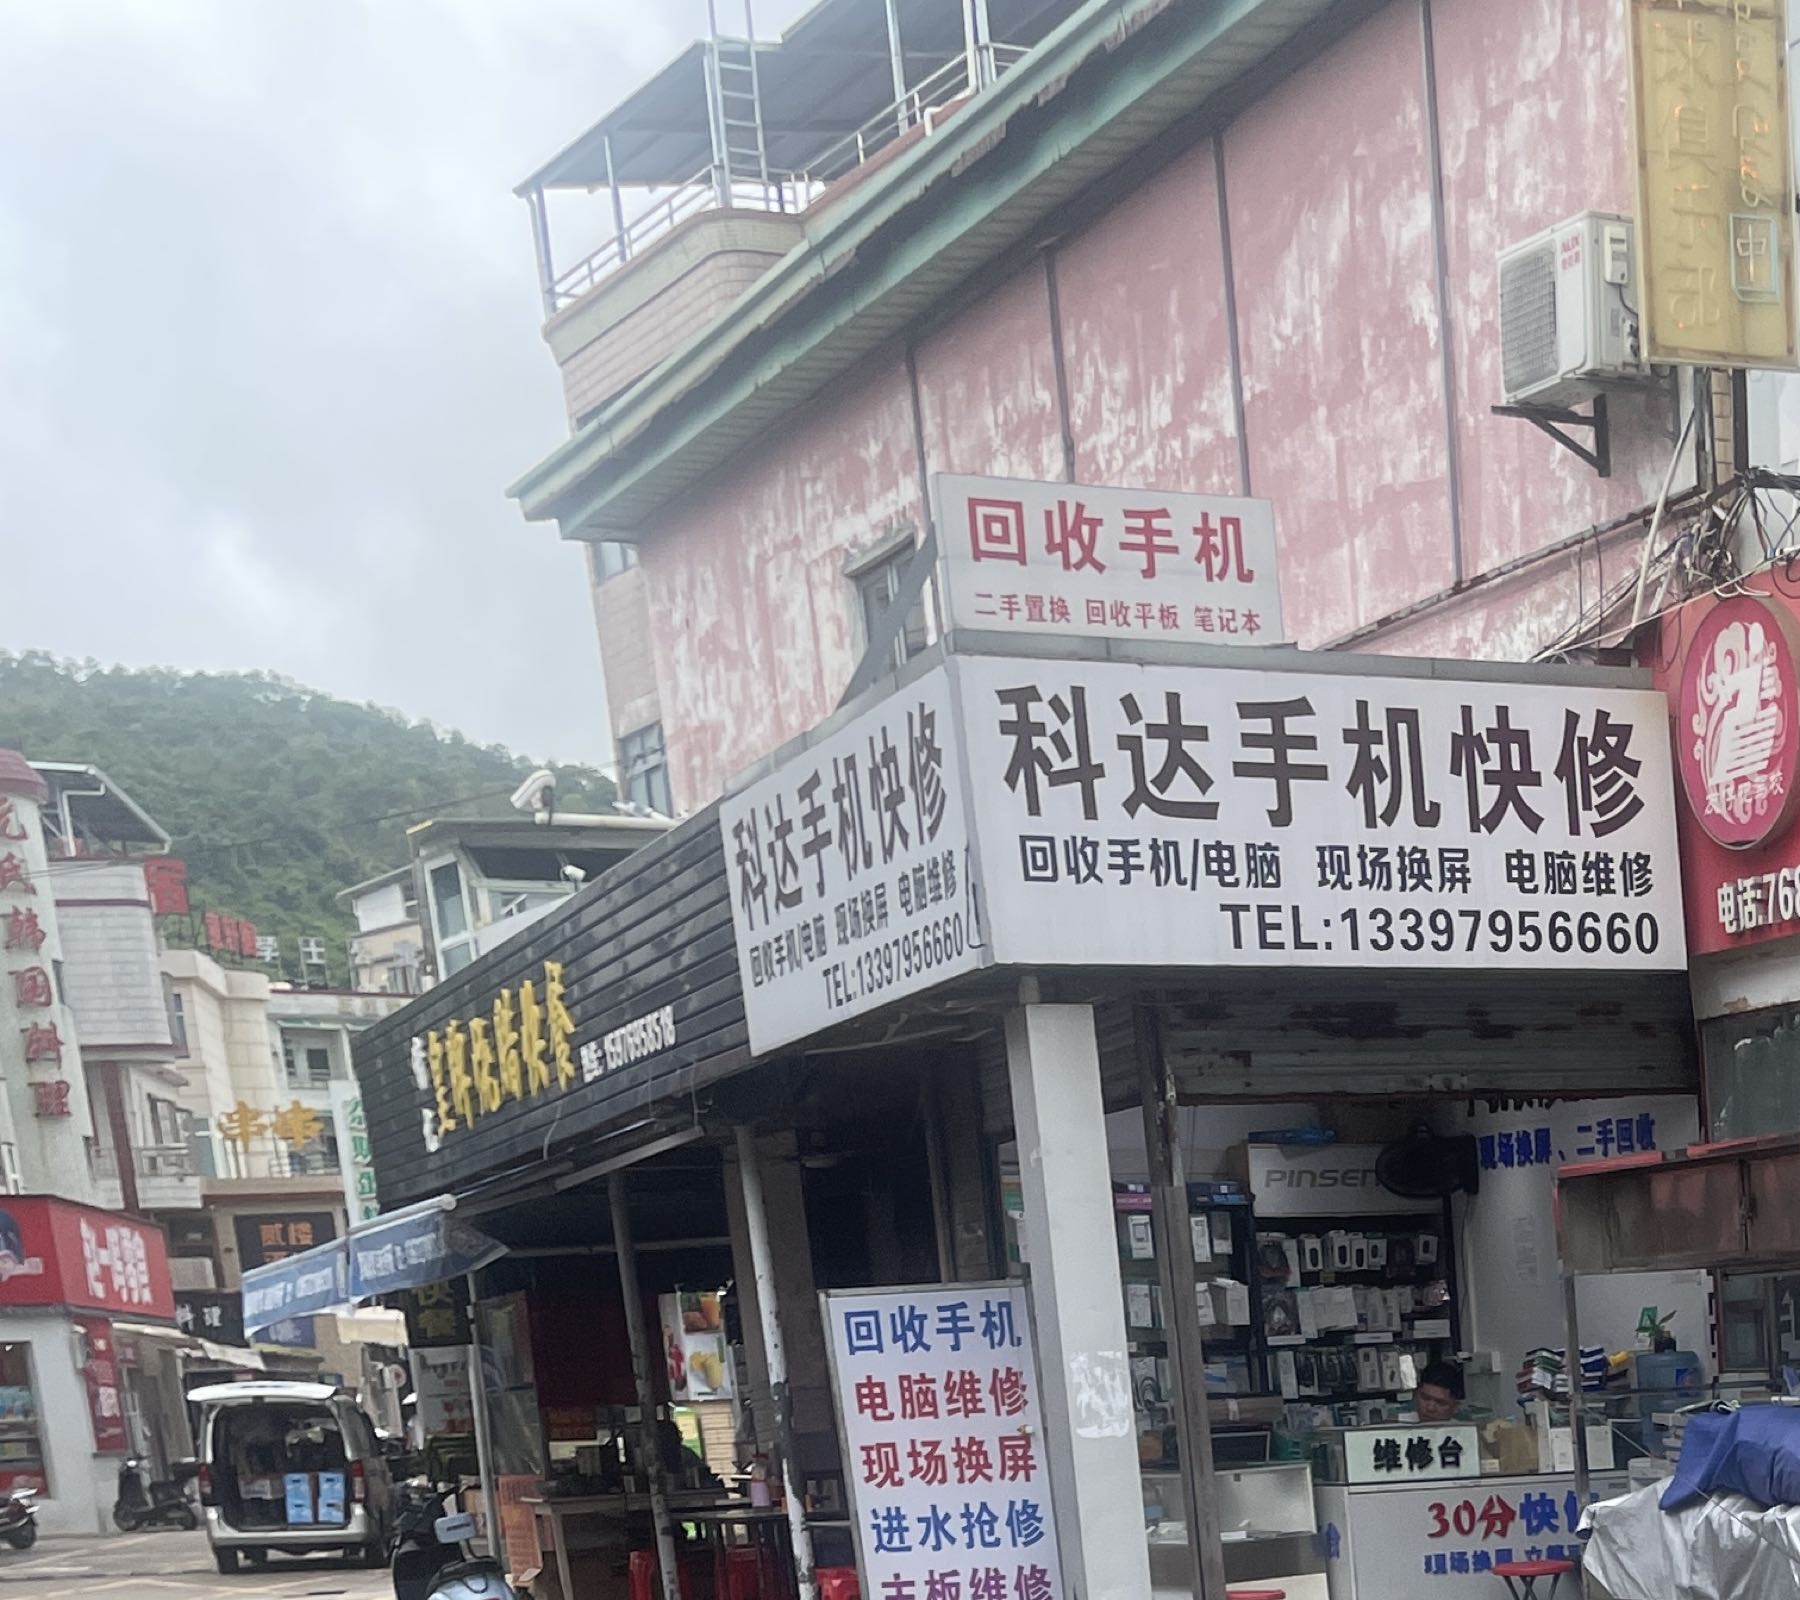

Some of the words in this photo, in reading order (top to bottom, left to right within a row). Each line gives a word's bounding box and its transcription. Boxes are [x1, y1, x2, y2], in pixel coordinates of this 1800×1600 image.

[967, 497, 1254, 583] 回收手机
[974, 592, 1071, 626] 二手置换
[1085, 598, 1180, 630] 回收平板
[1194, 605, 1262, 637] 笔记本
[995, 683, 1645, 839] 科达手机快修
[732, 701, 948, 932] 科达手机快修
[1018, 834, 1282, 892] 回收手机/电脑
[1316, 843, 1473, 895] 现场换屏
[1505, 848, 1655, 899] 电脑维修
[1220, 903, 1660, 956] TEL:13397956660
[823, 910, 965, 1011] TEL:13397956660
[843, 1299, 1023, 1356] 回收手机
[853, 1365, 1030, 1423] 电脑维修
[859, 1433, 1038, 1490] 现场换屏
[1371, 1434, 1466, 1474] 维修台
[870, 1498, 1046, 1555] 进水抢修
